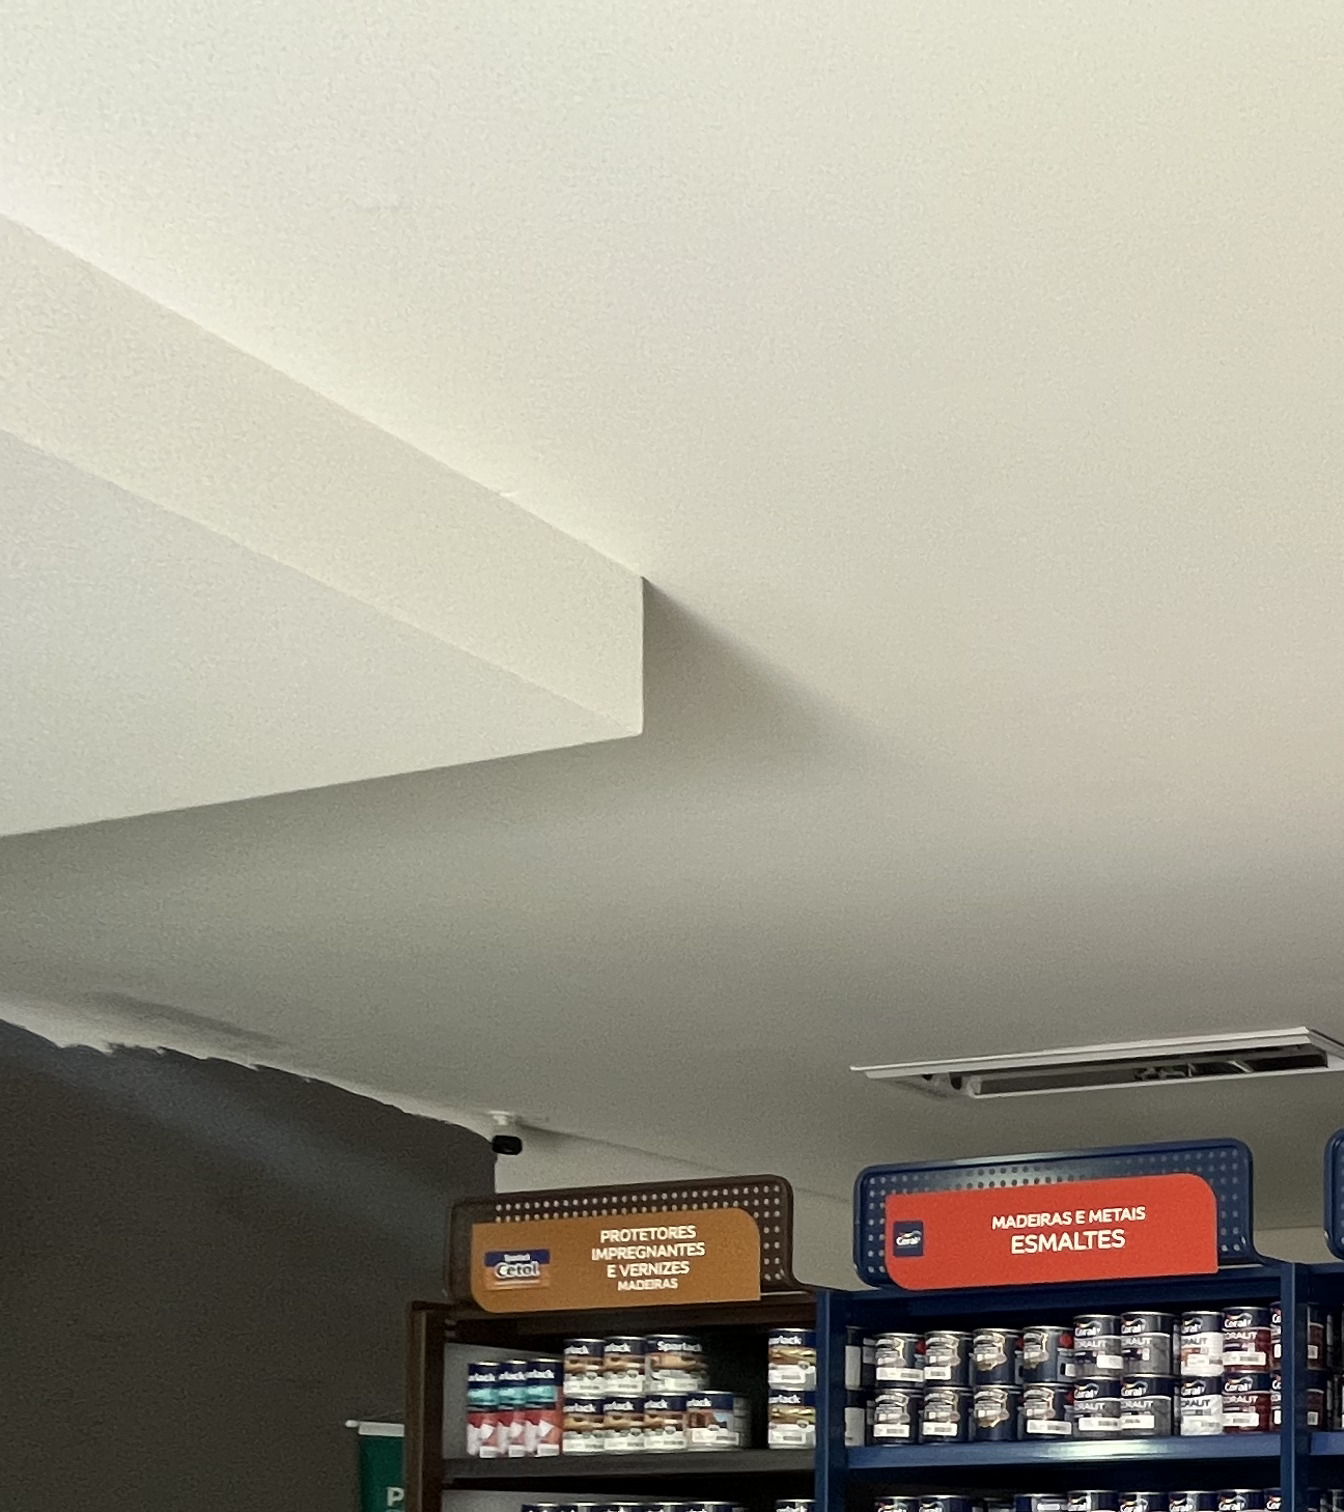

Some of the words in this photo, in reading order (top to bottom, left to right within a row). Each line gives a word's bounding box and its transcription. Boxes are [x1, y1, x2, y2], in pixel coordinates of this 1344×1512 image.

[992, 1213, 1071, 1230] MADEIRAS
[1076, 1210, 1085, 1225] E
[1090, 1206, 1146, 1223] METAIS
[600, 1225, 696, 1243] PROTETORES
[895, 1231, 919, 1247] Coral
[1010, 1229, 1126, 1256] ESMALTES
[591, 1242, 705, 1261] IMPREGNANTES
[494, 1262, 540, 1279] Cetol
[607, 1264, 617, 1278] E
[619, 1261, 690, 1277] VERNIZES
[618, 1278, 678, 1291] MADEIRAS
